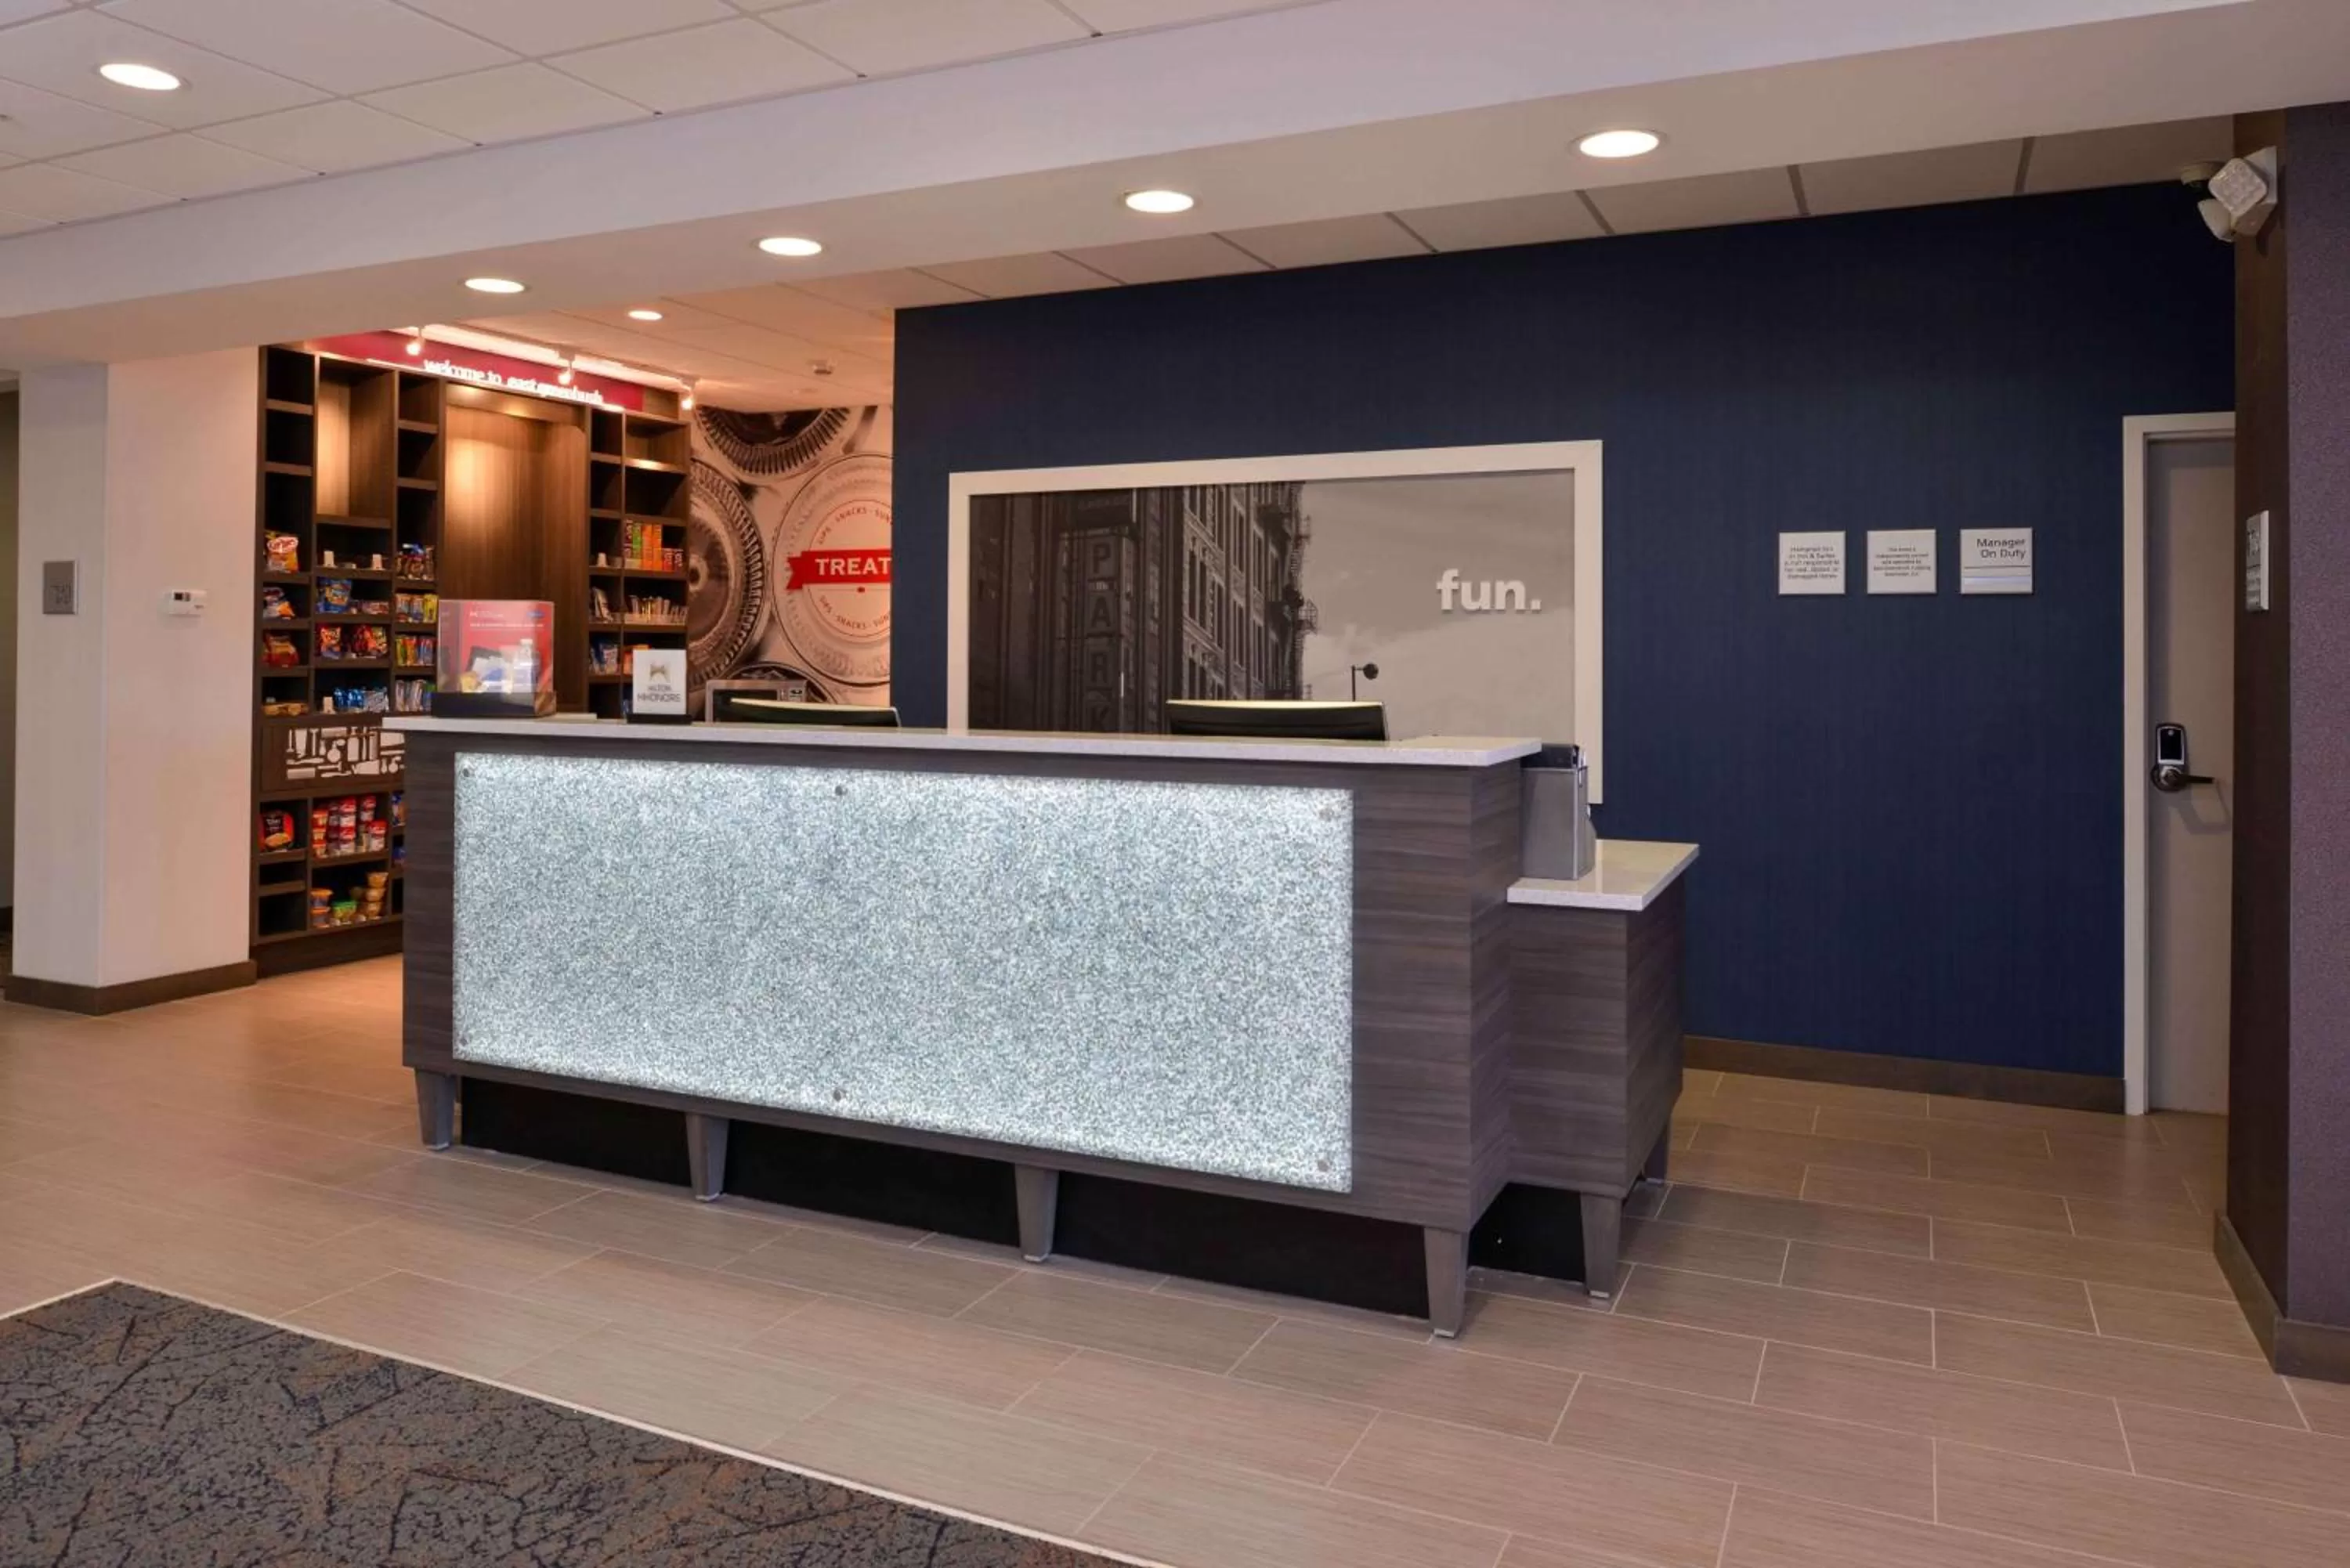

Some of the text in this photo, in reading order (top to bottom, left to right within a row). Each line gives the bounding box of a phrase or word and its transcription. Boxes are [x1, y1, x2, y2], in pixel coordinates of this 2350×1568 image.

[424, 359, 485, 381] welcome
[1976, 538, 2026, 549] Manager
[1980, 548, 2026, 562] On Duty
[815, 557, 892, 576] TREAT
[1436, 568, 1542, 610] fun.
